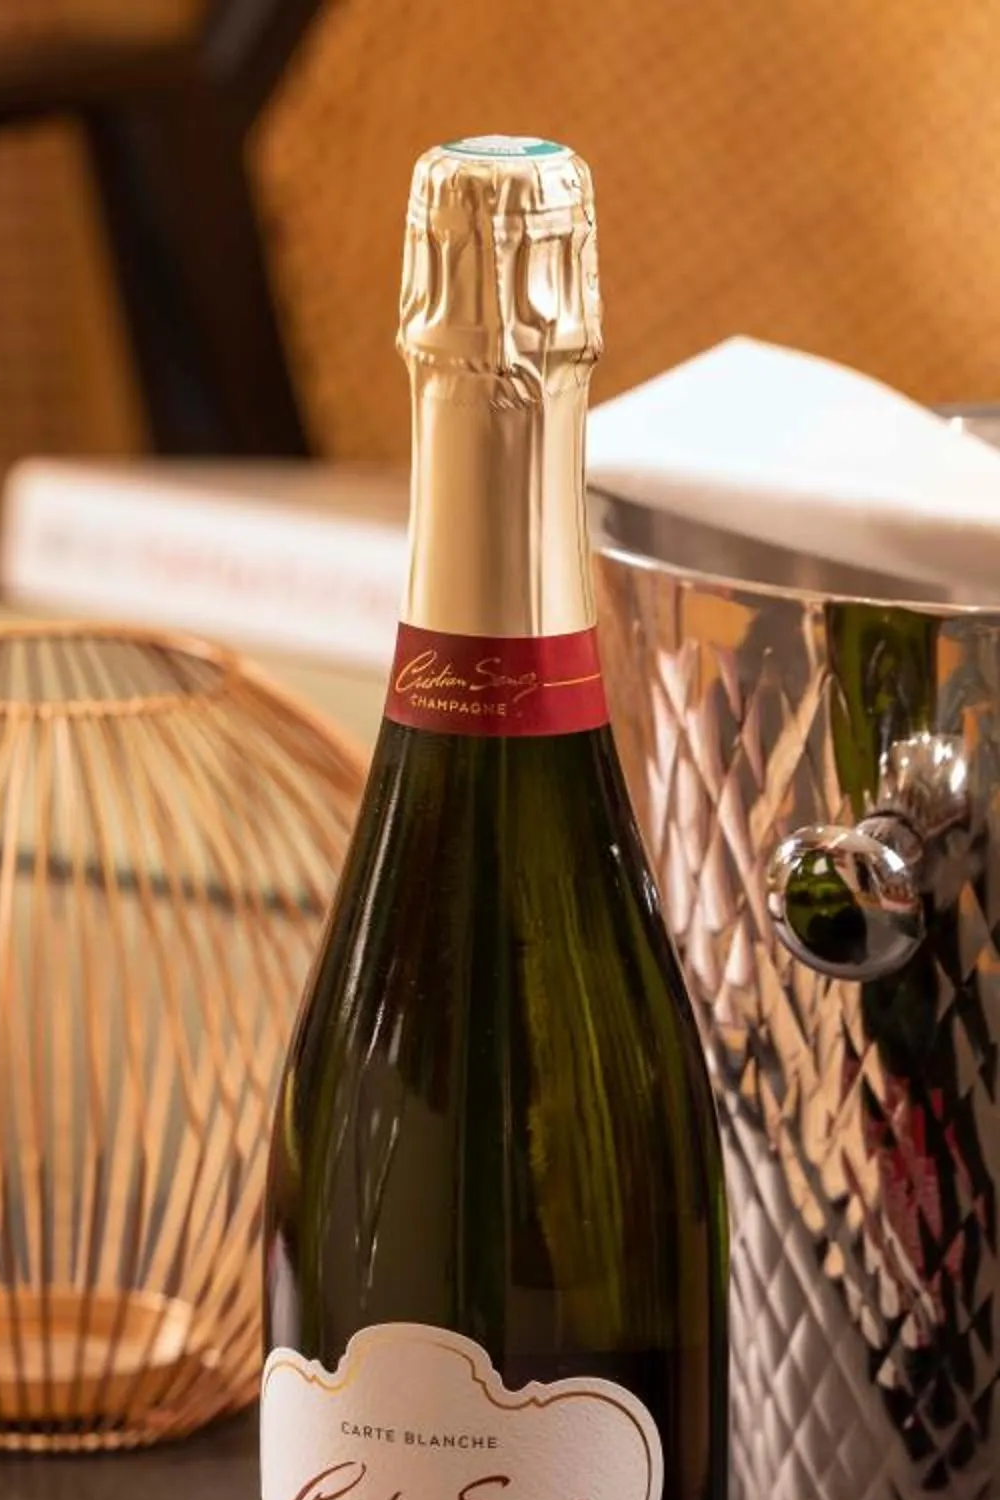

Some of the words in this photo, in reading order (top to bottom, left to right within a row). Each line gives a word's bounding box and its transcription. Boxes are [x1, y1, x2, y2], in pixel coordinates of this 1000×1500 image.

[410, 693, 507, 717] CHAMPAGNE
[341, 1421, 395, 1443] CARTE
[404, 1430, 499, 1450] BLANCHE
